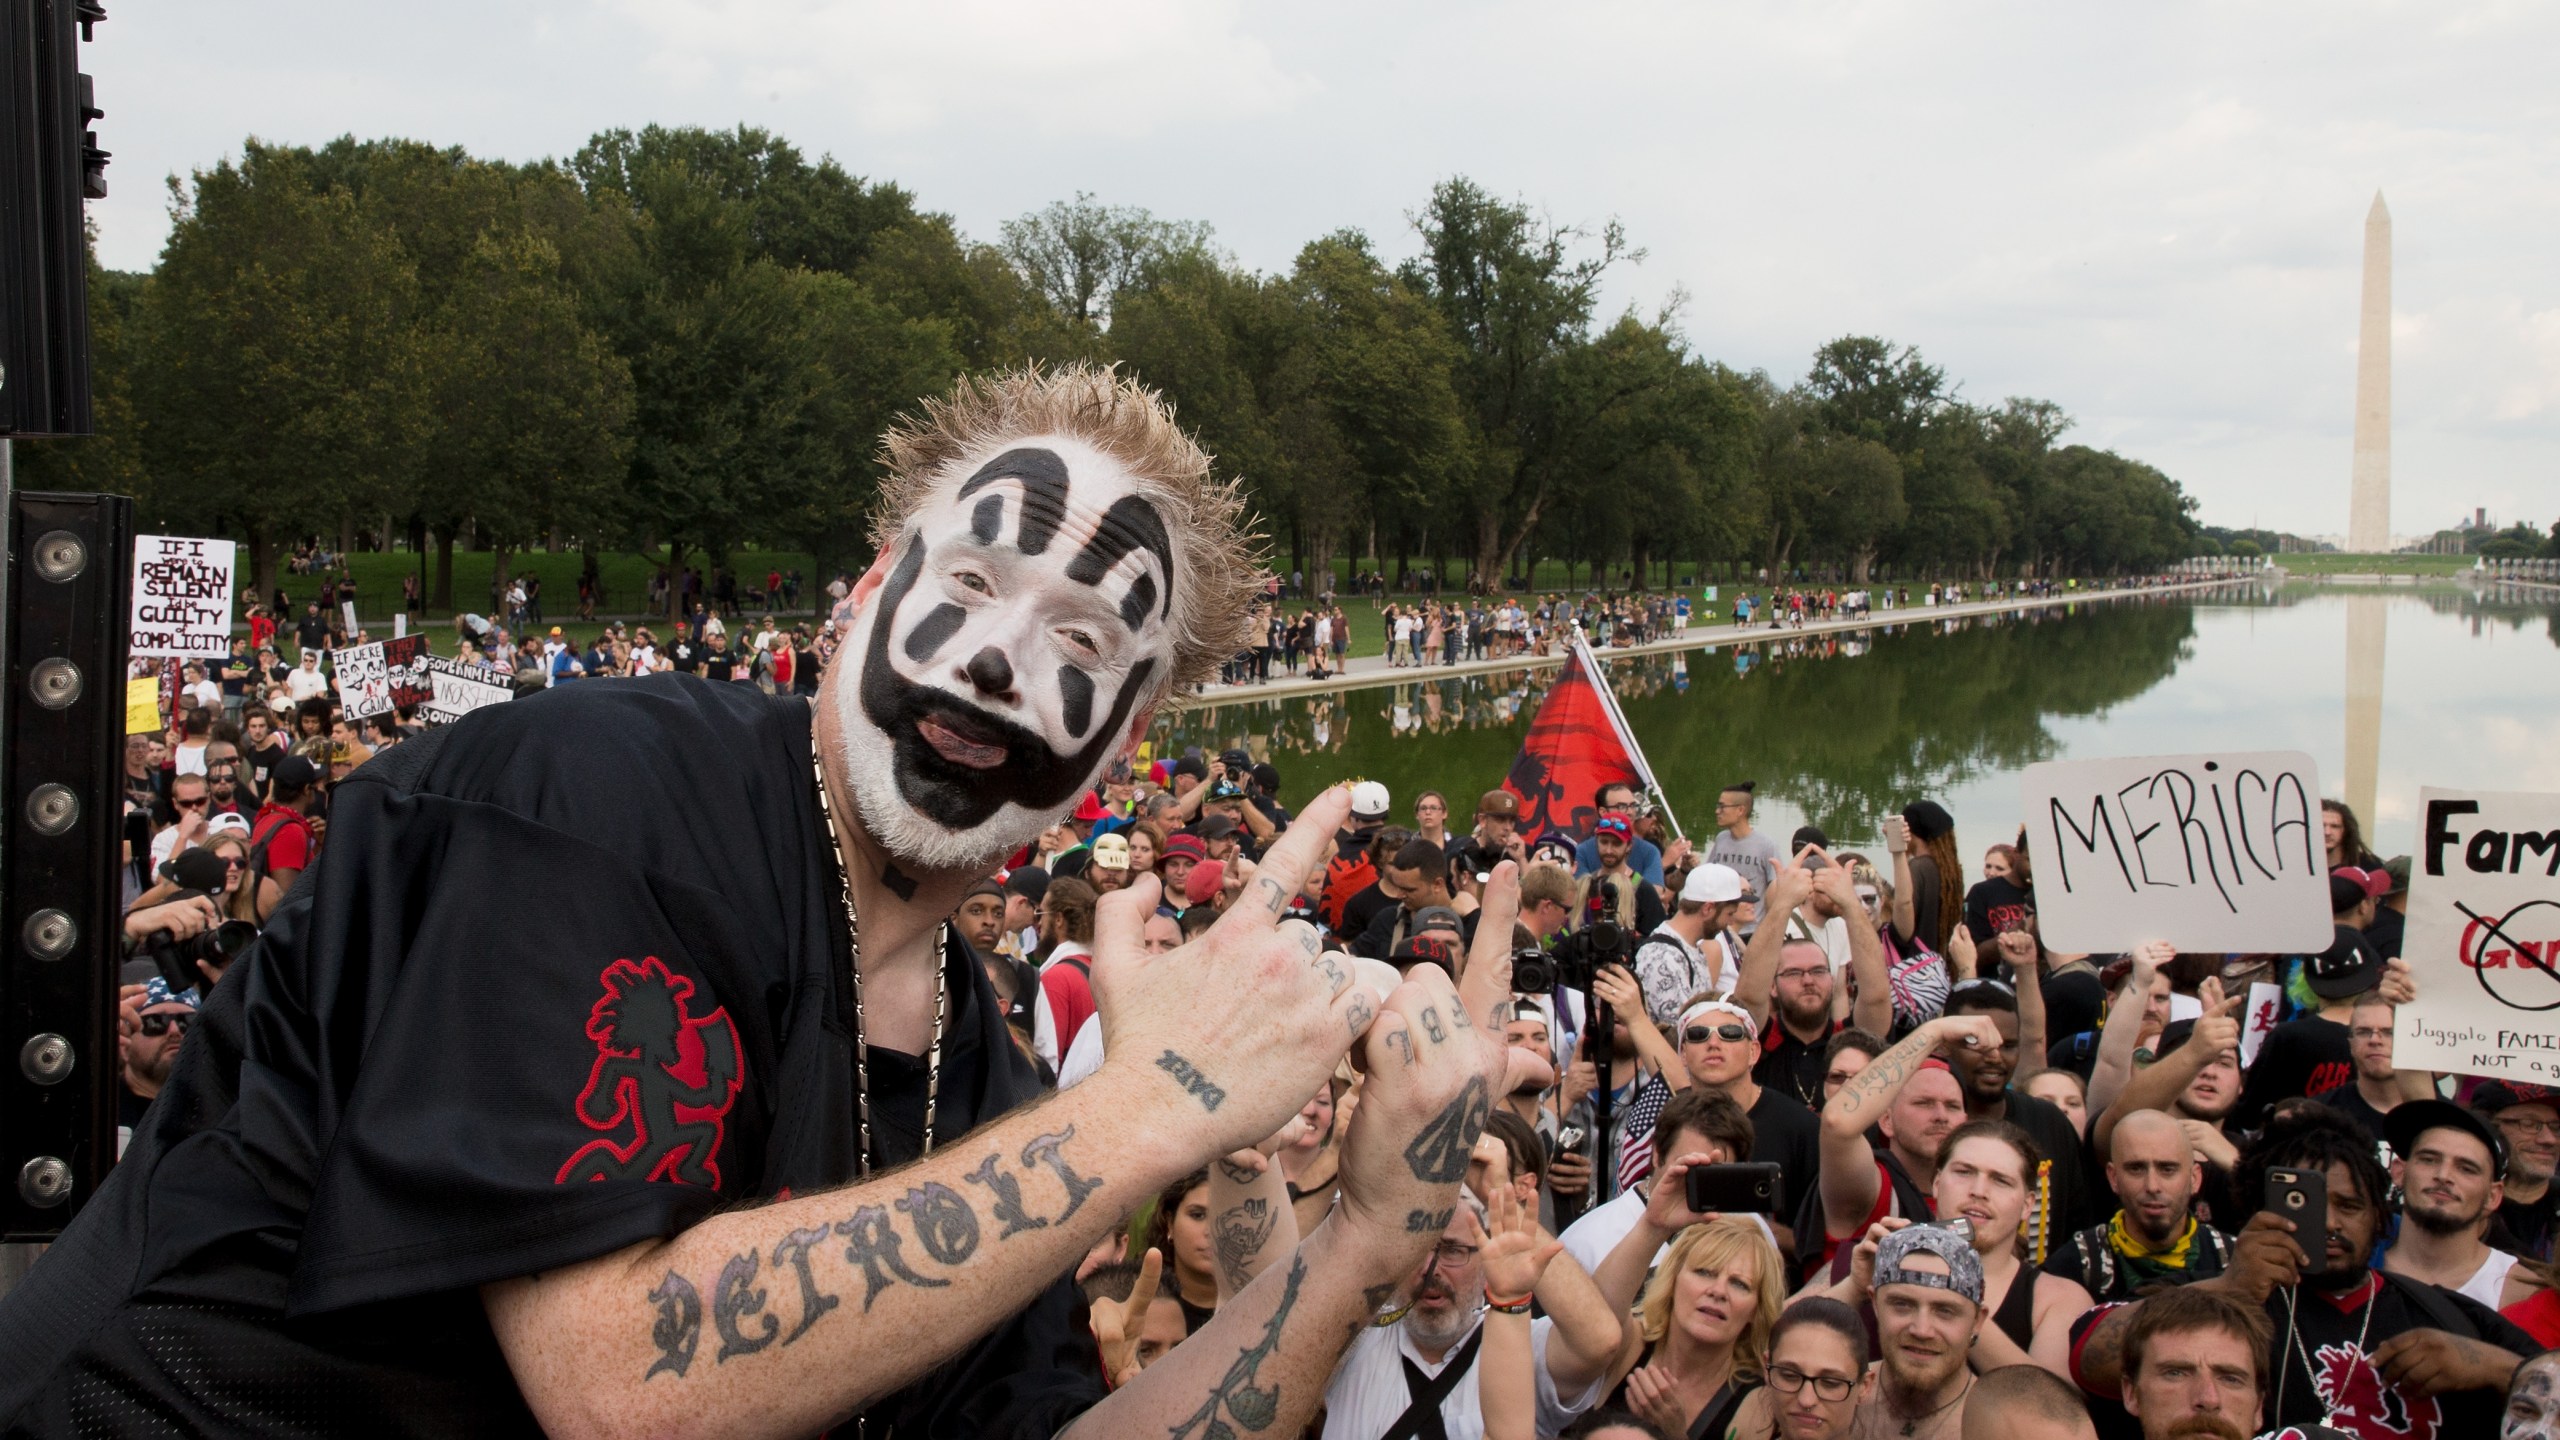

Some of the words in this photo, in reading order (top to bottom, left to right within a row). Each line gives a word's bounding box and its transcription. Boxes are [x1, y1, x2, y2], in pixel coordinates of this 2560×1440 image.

[158, 539, 185, 555] IF
[188, 541, 204, 557] I
[192, 558, 204, 567] to
[141, 561, 227, 587] REMAIN
[139, 604, 223, 625] GUILTY
[131, 630, 231, 652] COMPLICITY
[334, 651, 350, 666] IF
[428, 657, 511, 688] GOVERNMENT
[432, 679, 508, 710] ENSORSHIP
[344, 704, 356, 720] A
[416, 705, 430, 722] IS
[2411, 1017, 2487, 1047] Juggalo
[2472, 1054, 2518, 1069] NOT
[2530, 1061, 2544, 1072] a
[645, 1123, 1104, 1382] DETROIT
